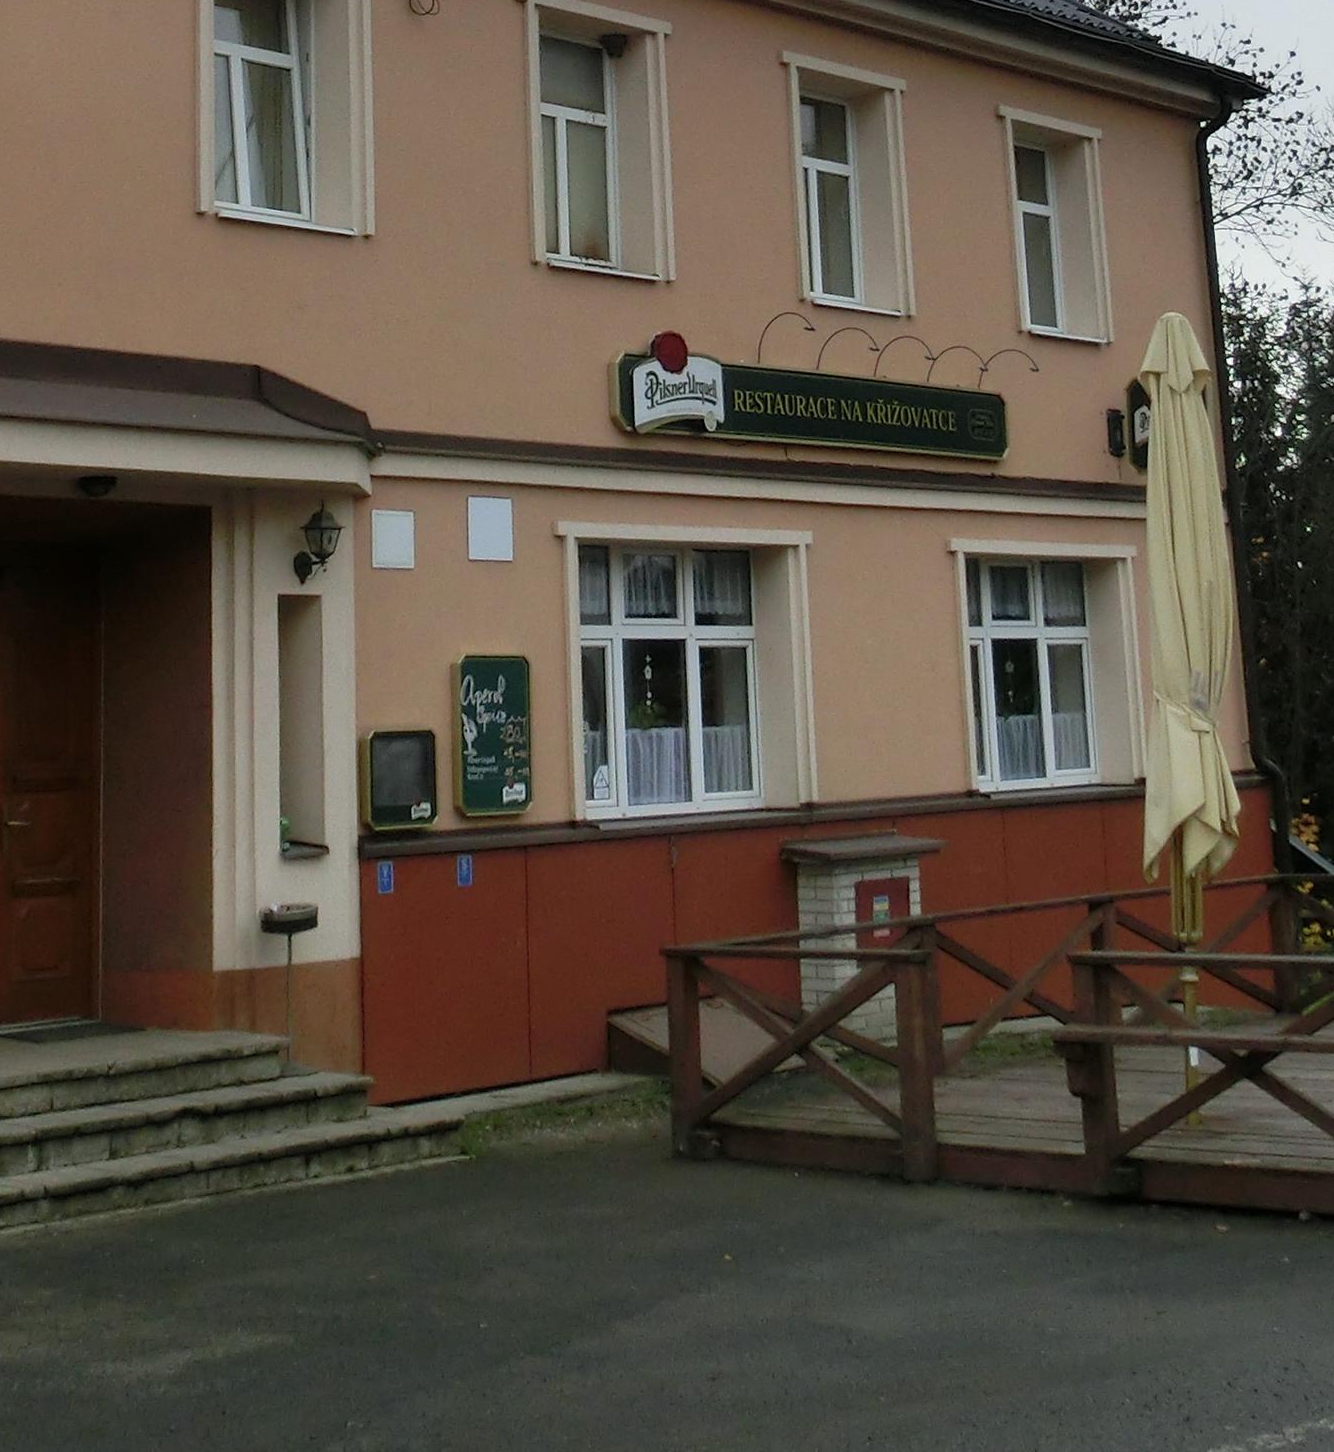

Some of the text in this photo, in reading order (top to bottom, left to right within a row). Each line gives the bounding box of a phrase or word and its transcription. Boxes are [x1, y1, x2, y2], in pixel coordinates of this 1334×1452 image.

[645, 370, 717, 410] Pilsner Urquell
[733, 388, 838, 420] RESTAURACE
[840, 399, 863, 423] NA
[866, 398, 958, 432] KŘIŽOVATCE
